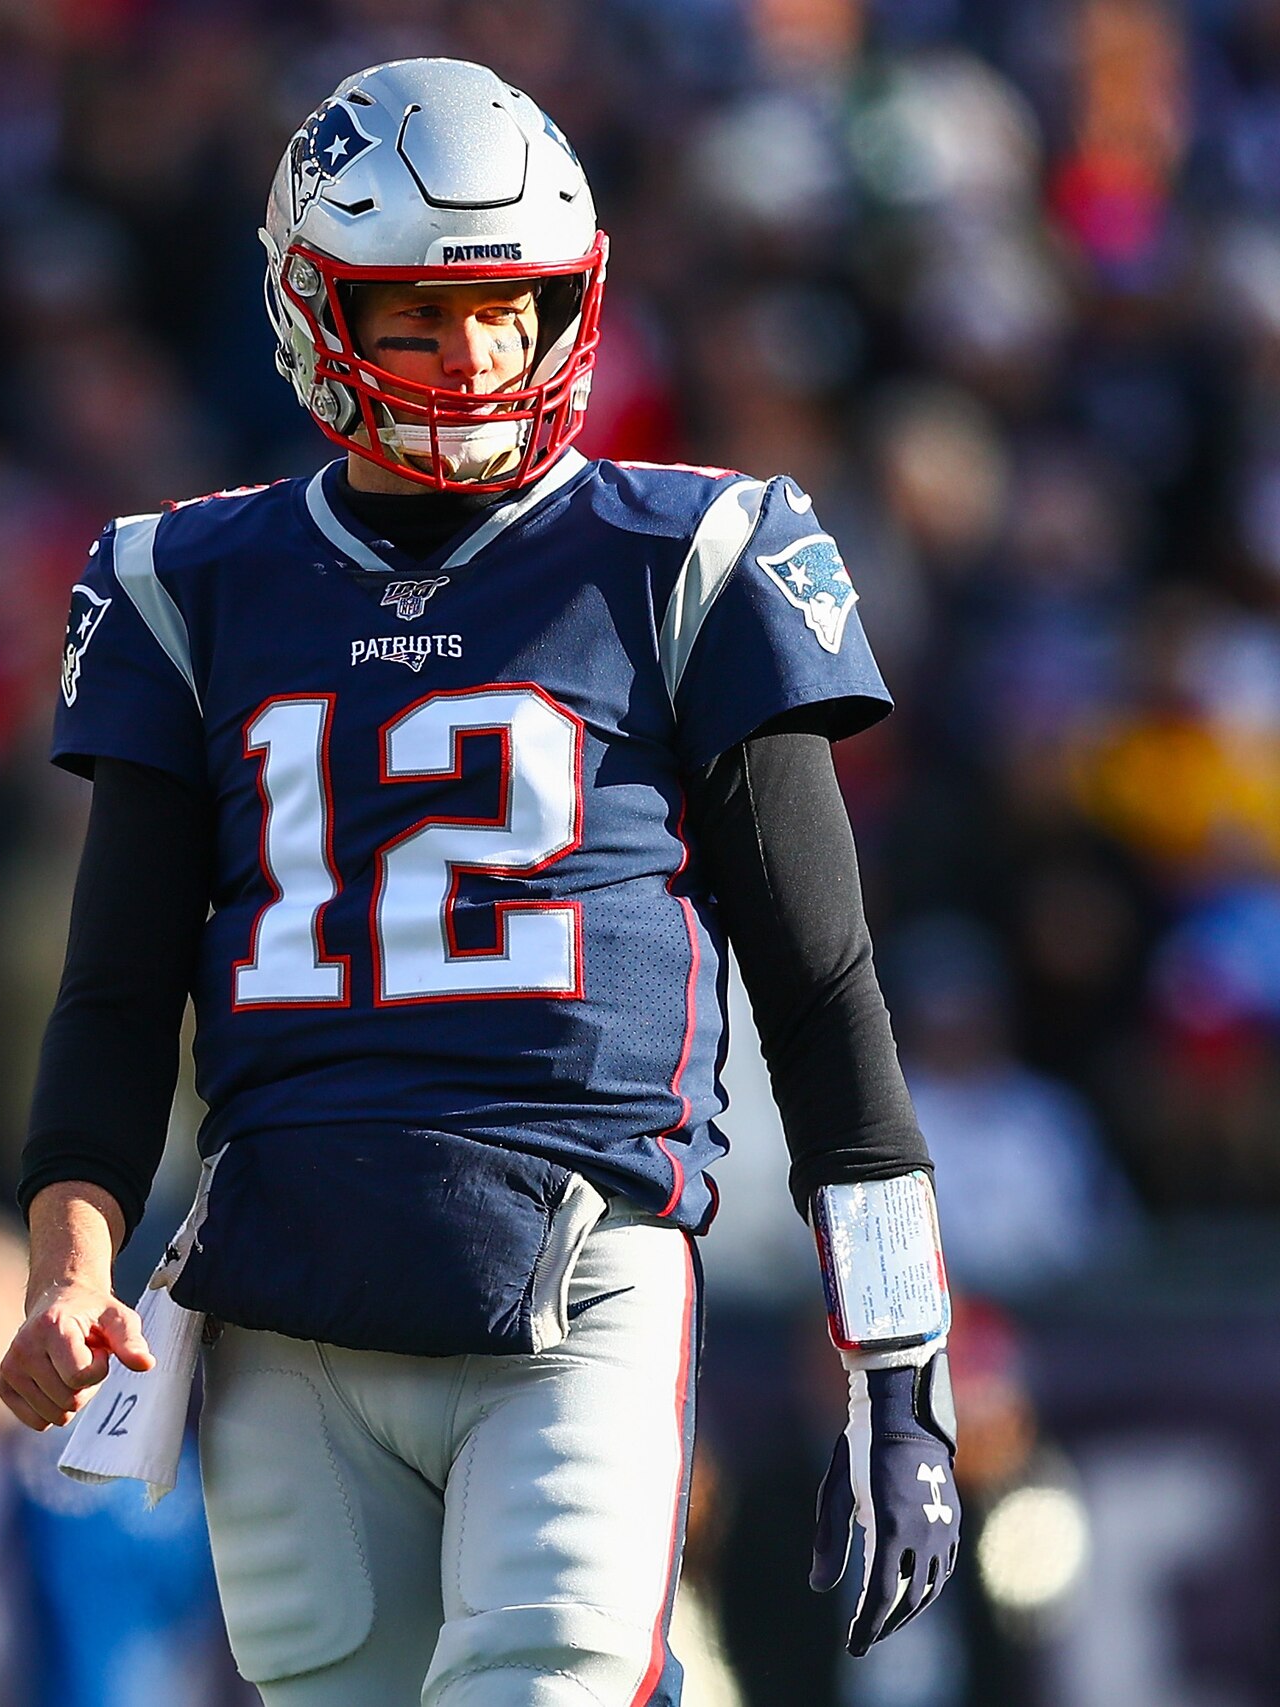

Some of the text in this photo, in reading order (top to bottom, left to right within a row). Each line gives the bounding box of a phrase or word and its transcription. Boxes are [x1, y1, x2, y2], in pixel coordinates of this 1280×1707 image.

[442, 243, 522, 265] PATRIOTS
[351, 634, 463, 666] PATRIOTS
[232, 682, 585, 1013] 12
[96, 1391, 138, 1437] 12
